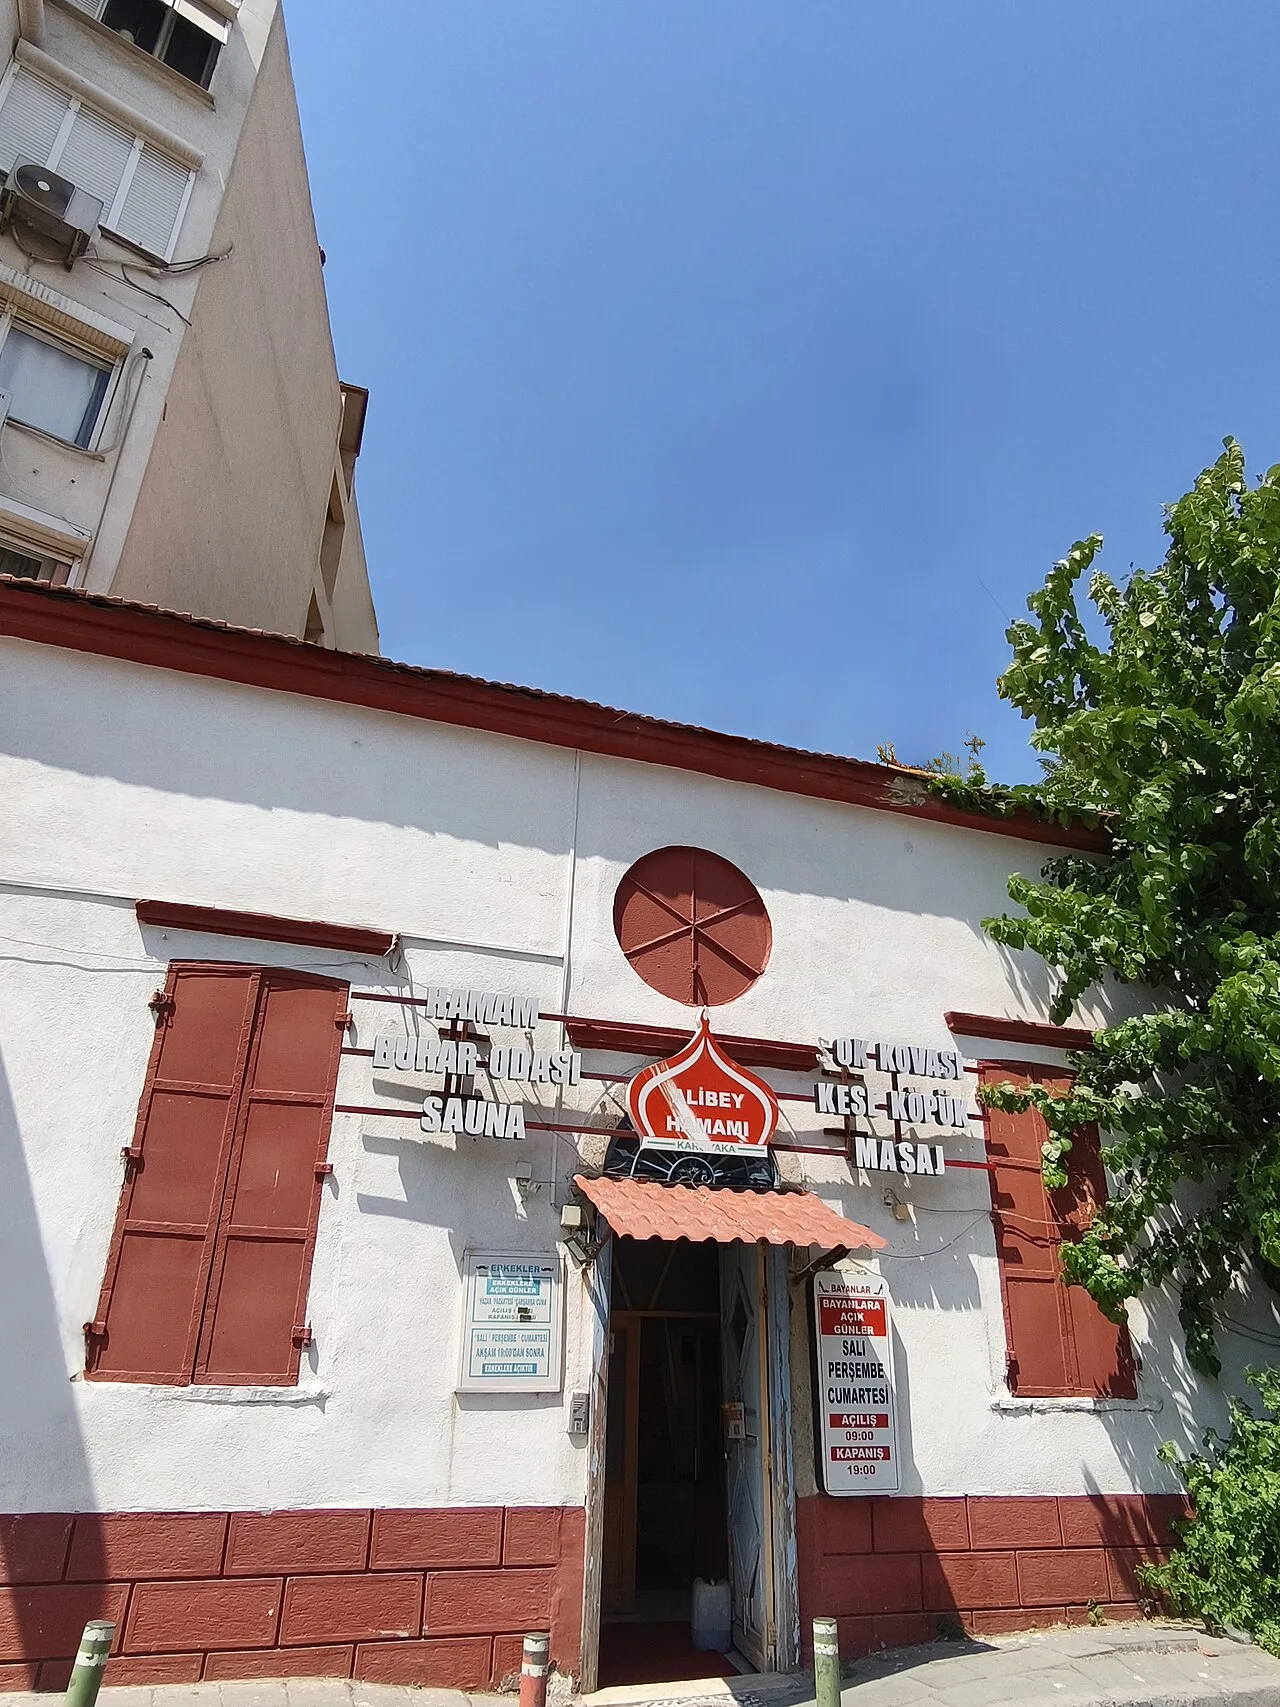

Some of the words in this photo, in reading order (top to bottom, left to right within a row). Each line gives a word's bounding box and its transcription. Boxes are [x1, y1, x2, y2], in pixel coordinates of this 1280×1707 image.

[426, 986, 540, 1029] HAMAM
[372, 1034, 477, 1076] BUHAR
[489, 1045, 581, 1086] ODASI
[875, 1042, 964, 1080] KOVASI
[421, 1096, 526, 1140] SAUNA
[666, 1115, 749, 1137] HMAMI
[852, 1137, 946, 1176] MASAJ
[490, 1264, 540, 1273] ERKEKLER
[508, 1286, 537, 1294] GÜNLER
[831, 1284, 871, 1294] BAYANLAR
[823, 1299, 881, 1310] BAYANLARA
[840, 1312, 865, 1323] AÇIK
[834, 1324, 874, 1335] GÜNLER
[525, 1347, 545, 1358] SONRA
[842, 1339, 866, 1356] SALI
[828, 1361, 885, 1382] PERŞEMBE
[827, 1384, 889, 1405] CUMARTESİ
[841, 1414, 877, 1427] AÇILIŞ
[845, 1431, 874, 1441] 09:00
[836, 1448, 884, 1461] KAPANIŞ
[847, 1465, 876, 1475] 19:00
